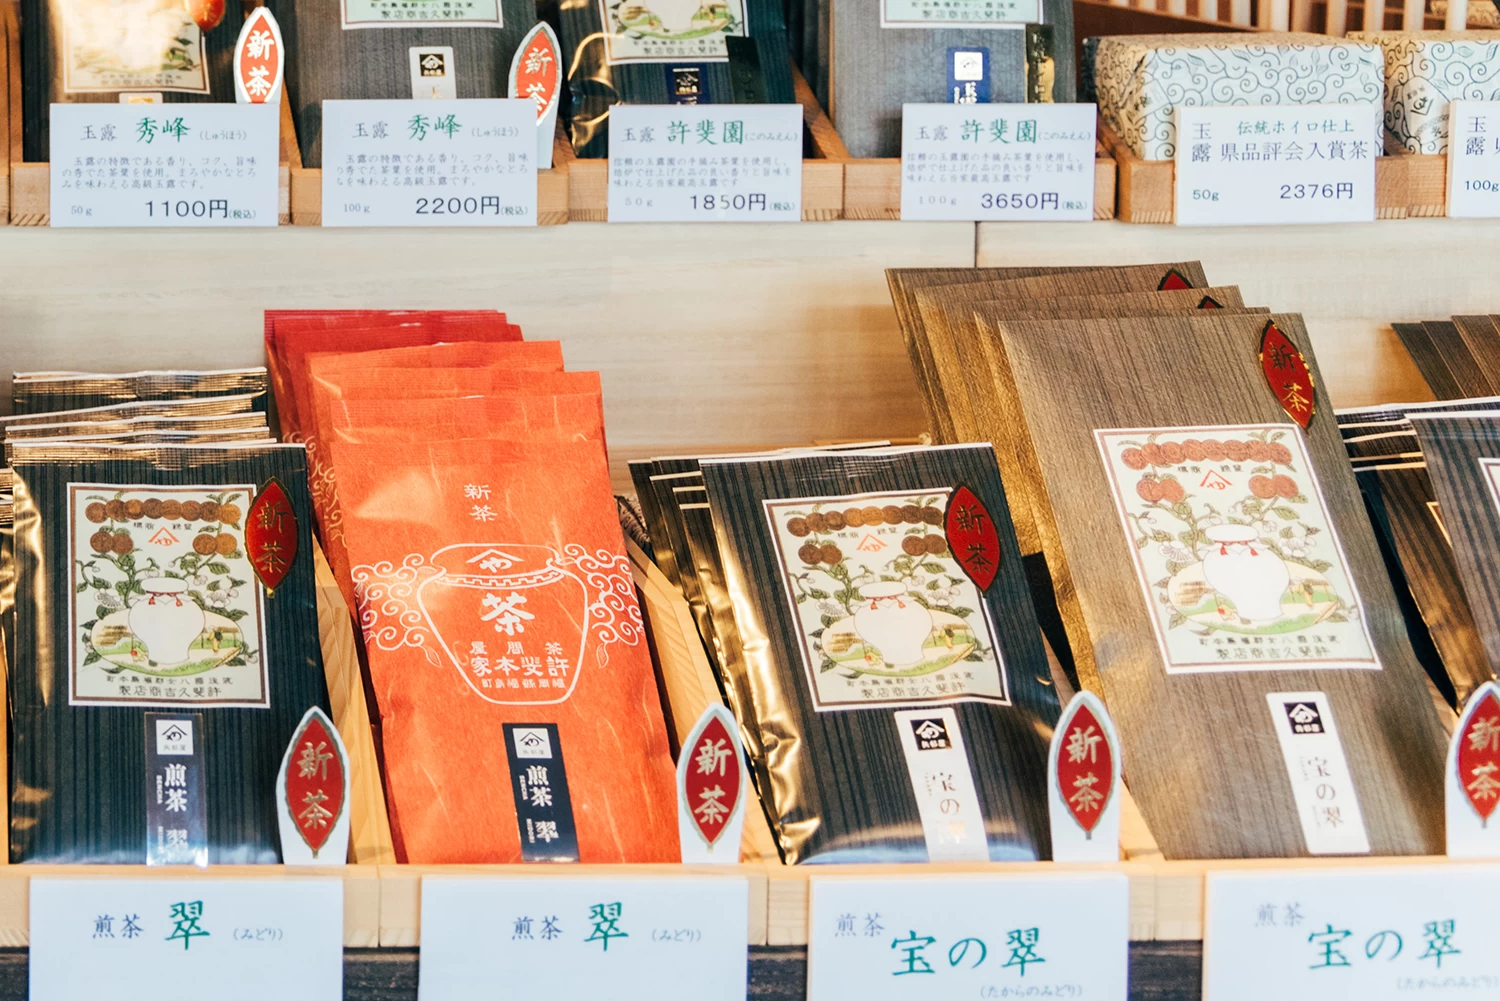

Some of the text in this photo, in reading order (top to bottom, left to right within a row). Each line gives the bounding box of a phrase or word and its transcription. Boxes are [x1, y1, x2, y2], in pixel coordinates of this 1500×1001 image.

[245, 28, 275, 97] 新茶
[524, 46, 552, 112] 新茶
[80, 124, 118, 142] 玉露
[136, 116, 191, 144] 秀峰
[352, 120, 390, 139] 玉露
[407, 113, 463, 142] 秀峰
[621, 127, 657, 143] 玉露
[666, 119, 744, 145] 許斐園
[914, 125, 949, 141] 玉露
[960, 118, 1038, 145] 許斐園
[1191, 121, 1212, 163] 玉露
[1219, 140, 1368, 163] 県品評会入賞茶
[1236, 119, 1356, 136] 伝統ホイロ仕上
[1464, 115, 1488, 157] 玉露
[145, 199, 228, 219] 1100円
[415, 196, 500, 215] 2200円
[689, 193, 767, 212] 1850円
[980, 192, 1060, 211] 3650円
[1191, 182, 1354, 202] 50g 2376円
[1463, 179, 1500, 193] 100g
[1266, 343, 1310, 413] 新茶
[463, 482, 498, 523] 新茶
[255, 501, 293, 575] 新茶
[953, 504, 994, 575] 新茶
[480, 591, 536, 637] 茶
[693, 738, 733, 826] 新茶
[1065, 725, 1103, 813] 新茶
[1467, 715, 1500, 802] 新茶
[164, 762, 189, 813] 煎茶
[296, 740, 335, 830] 新茶
[525, 764, 560, 844] 煎茶 翠
[930, 770, 968, 845] 宝の
[91, 913, 145, 940] 煎茶
[164, 899, 211, 951] 翠
[511, 915, 565, 941] 煎茶
[583, 901, 629, 952] 翠
[834, 912, 1047, 978] 煎茶 宝の翠
[1255, 902, 1462, 969] 煎茶 宝の翠
